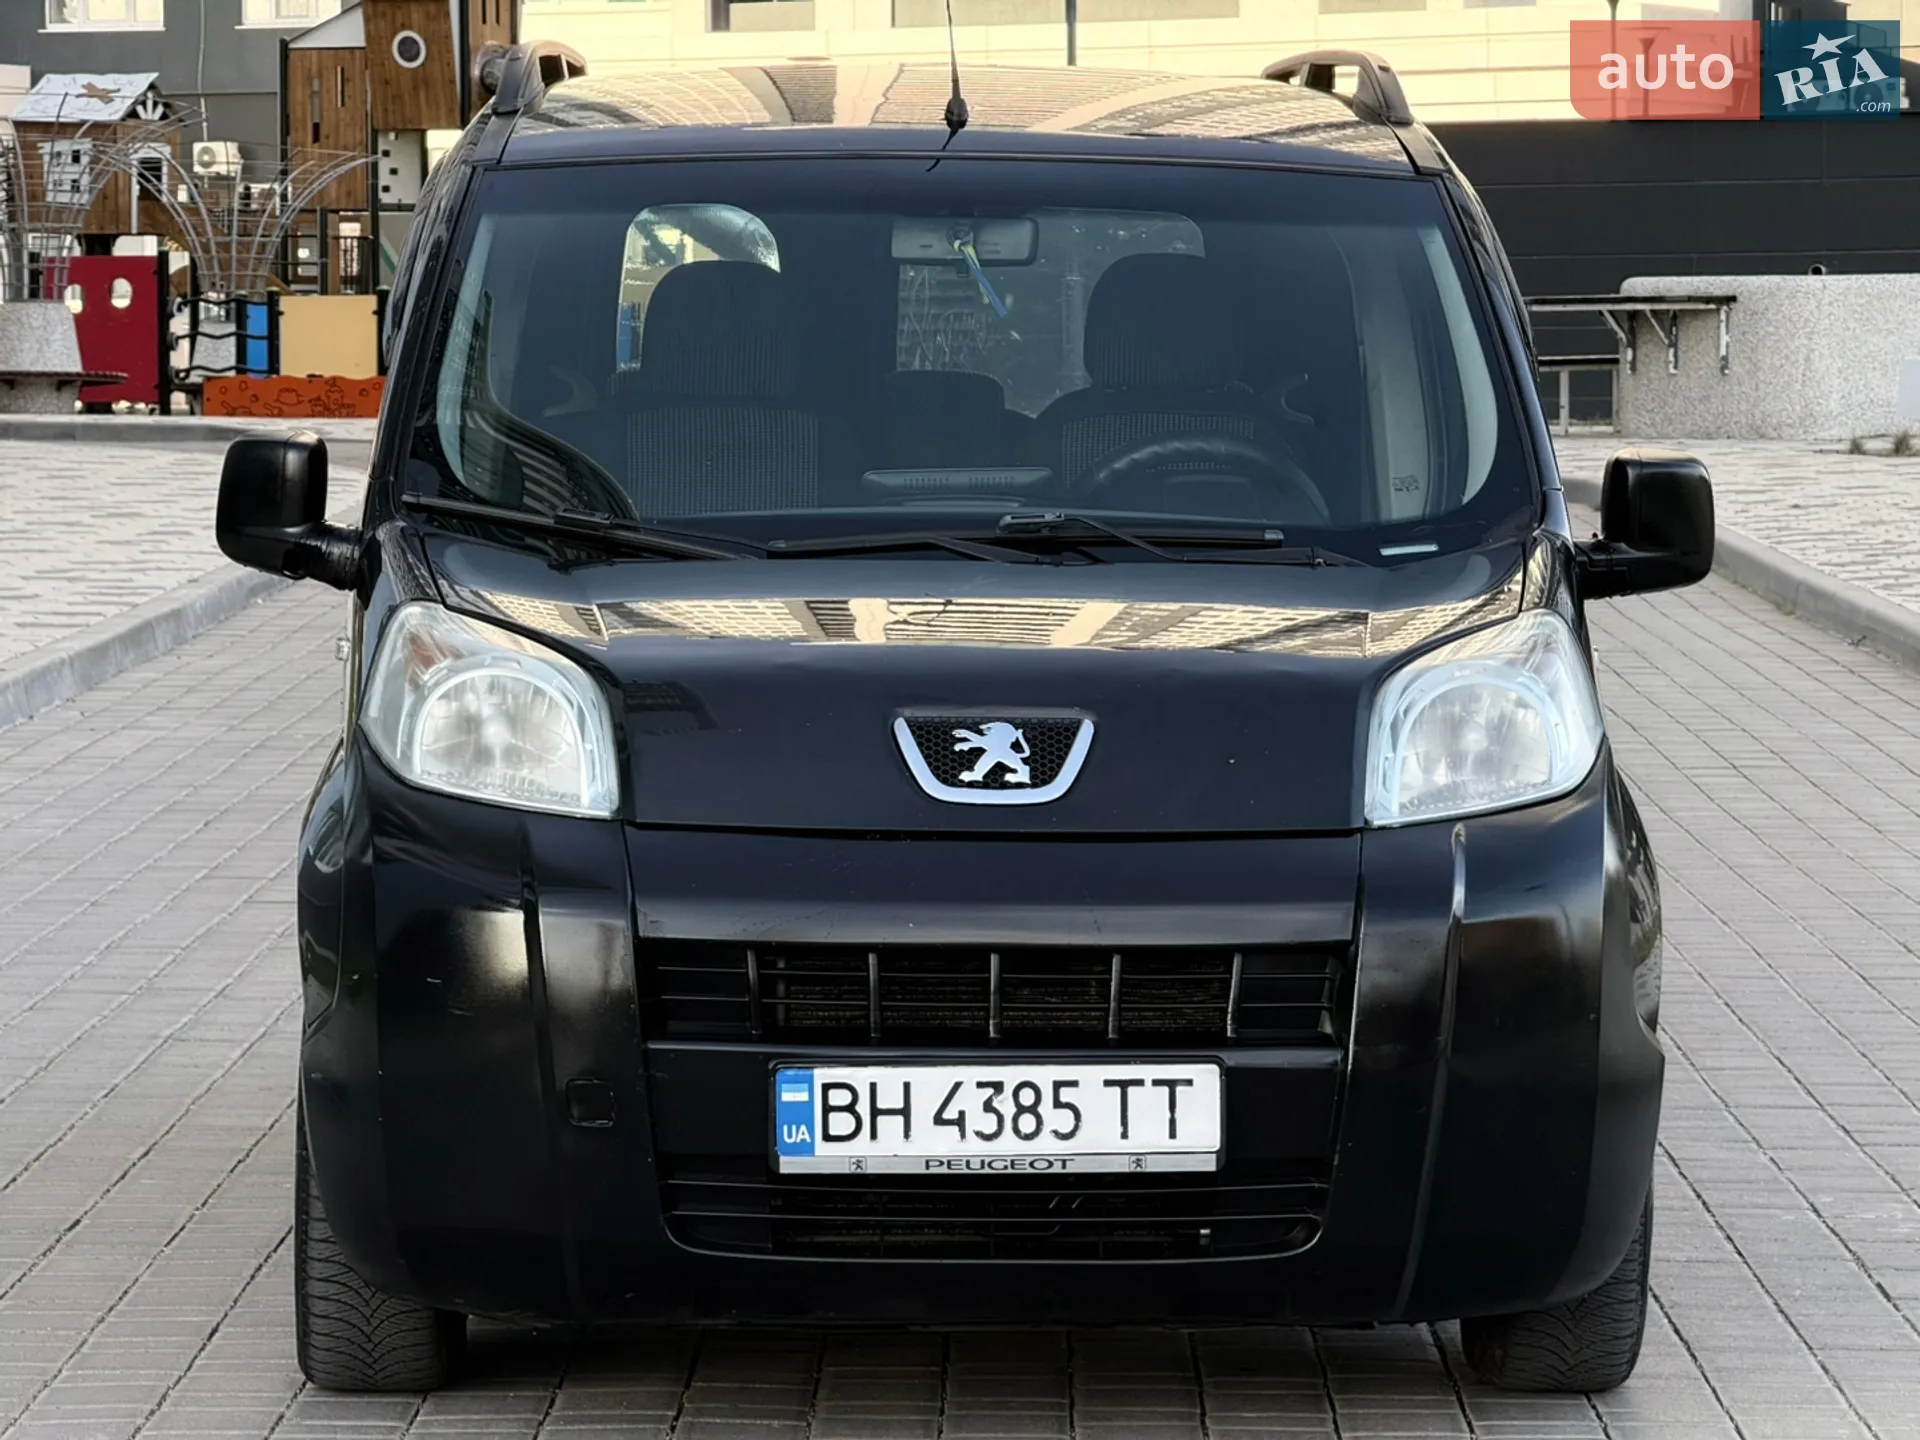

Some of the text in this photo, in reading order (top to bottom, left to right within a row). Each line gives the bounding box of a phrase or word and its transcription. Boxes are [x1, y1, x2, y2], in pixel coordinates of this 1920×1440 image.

[821, 1078, 1194, 1143] BH 4385 TT
[783, 1125, 811, 1143] UA
[924, 1158, 1076, 1172] PEUGEOT
